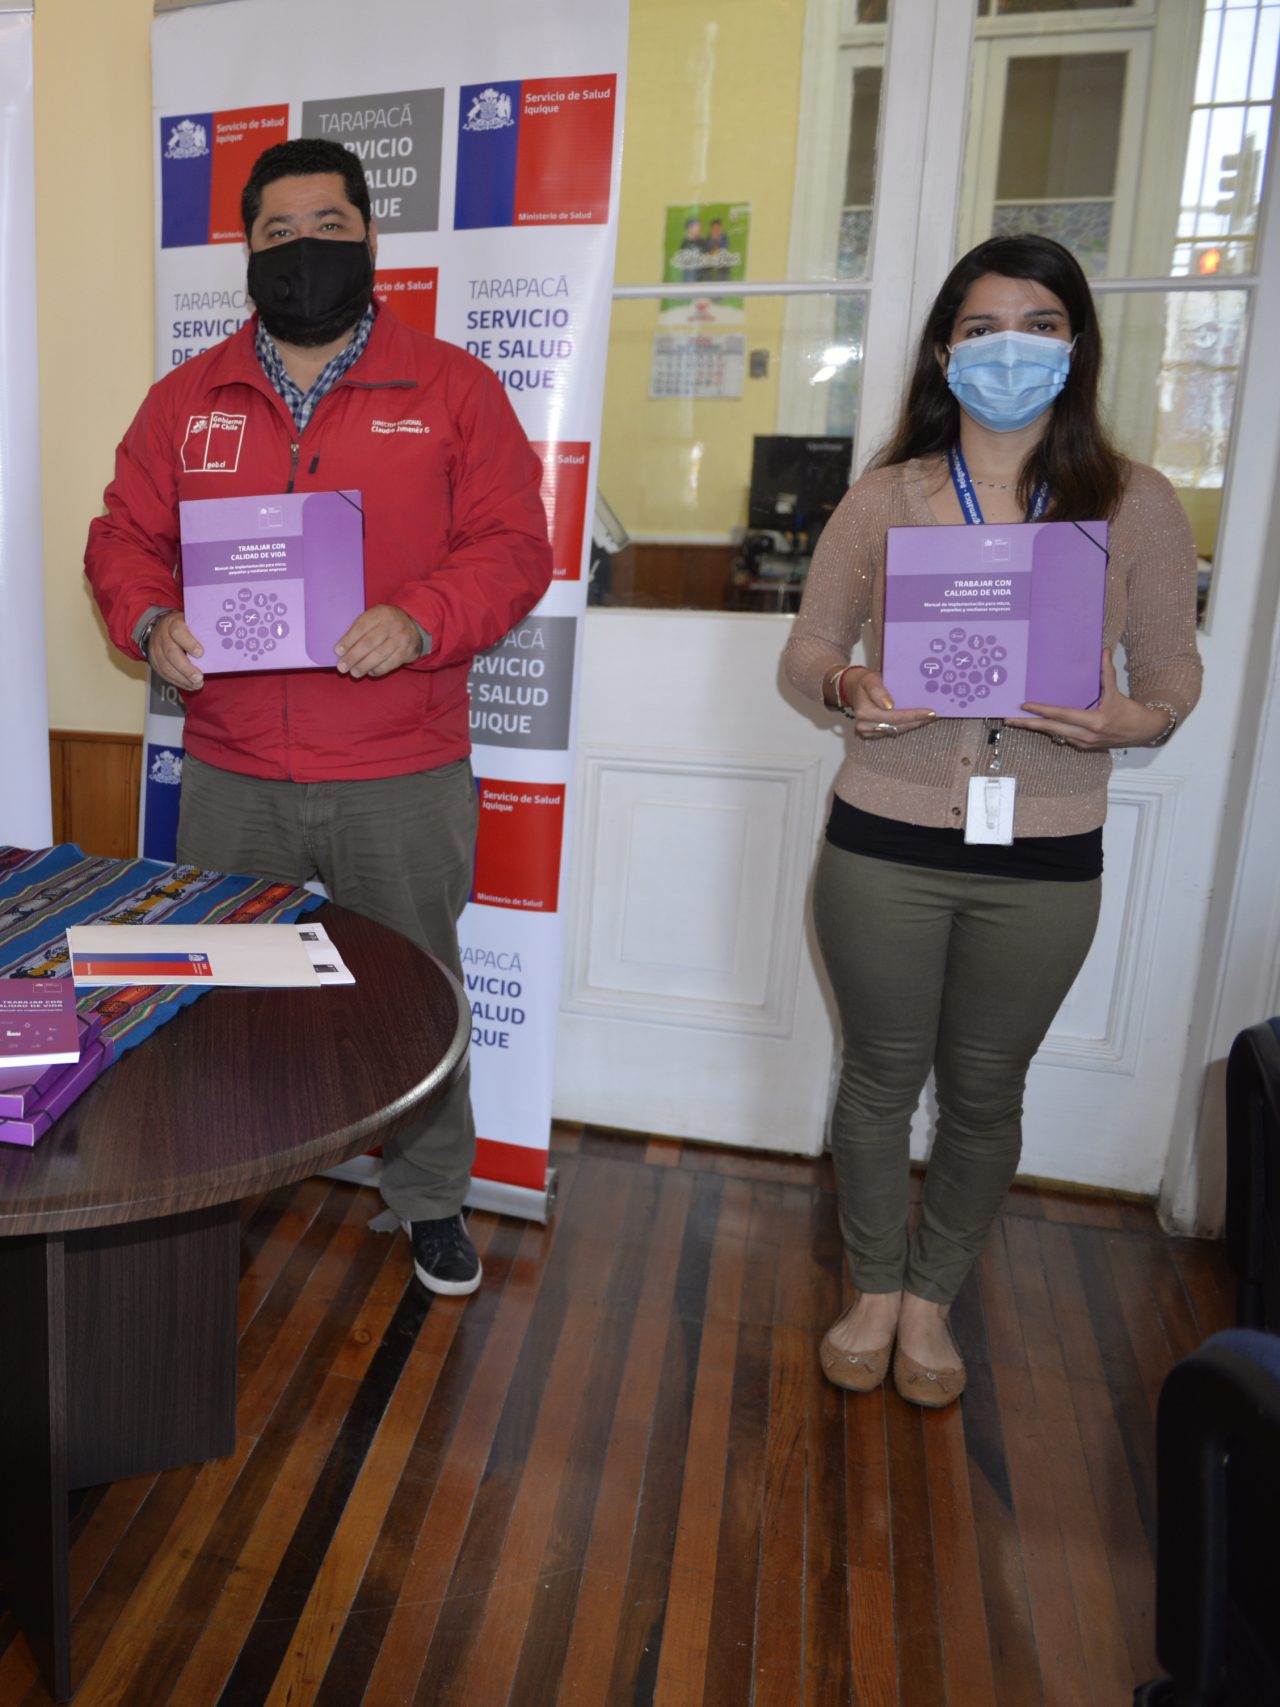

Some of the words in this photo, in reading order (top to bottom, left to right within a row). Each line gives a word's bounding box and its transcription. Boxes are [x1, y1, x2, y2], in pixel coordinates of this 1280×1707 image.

[525, 91, 565, 104] Servicio
[567, 91, 580, 101] de
[582, 88, 611, 100] Salud
[318, 103, 412, 134] TARAPACÁ
[524, 105, 559, 116] Iquique
[216, 121, 247, 133] Servicio
[248, 120, 259, 129] de
[260, 117, 285, 128] Salud
[344, 136, 413, 160] VICIO
[364, 167, 417, 189] ALUD
[407, 280, 433, 290] Salud
[469, 275, 569, 300] TARAPACÁ
[172, 318, 251, 339] SERVICI
[467, 308, 569, 330] SERVICIO
[466, 340, 492, 359] DE
[498, 339, 572, 359] SALUD
[495, 369, 555, 392] IQUE
[558, 455, 585, 465] Salud
[230, 553, 259, 561] CALIDAD
[238, 544, 271, 552] TRABAJAR
[944, 589, 979, 597] CALIDAD
[992, 588, 1012, 596] VIDA
[954, 580, 993, 588] TRABAJAR
[994, 579, 1012, 587] CON
[473, 654, 545, 678] RVICIO
[478, 683, 549, 707] SALUD
[469, 709, 532, 735] UIQUE
[482, 800, 513, 812] Iquique
[483, 789, 518, 802] Servicio
[520, 794, 532, 804] de
[534, 795, 560, 806] Salud
[459, 946, 522, 973] APACÁ
[465, 973, 522, 998] VICIO
[471, 1001, 526, 1025] ALUD
